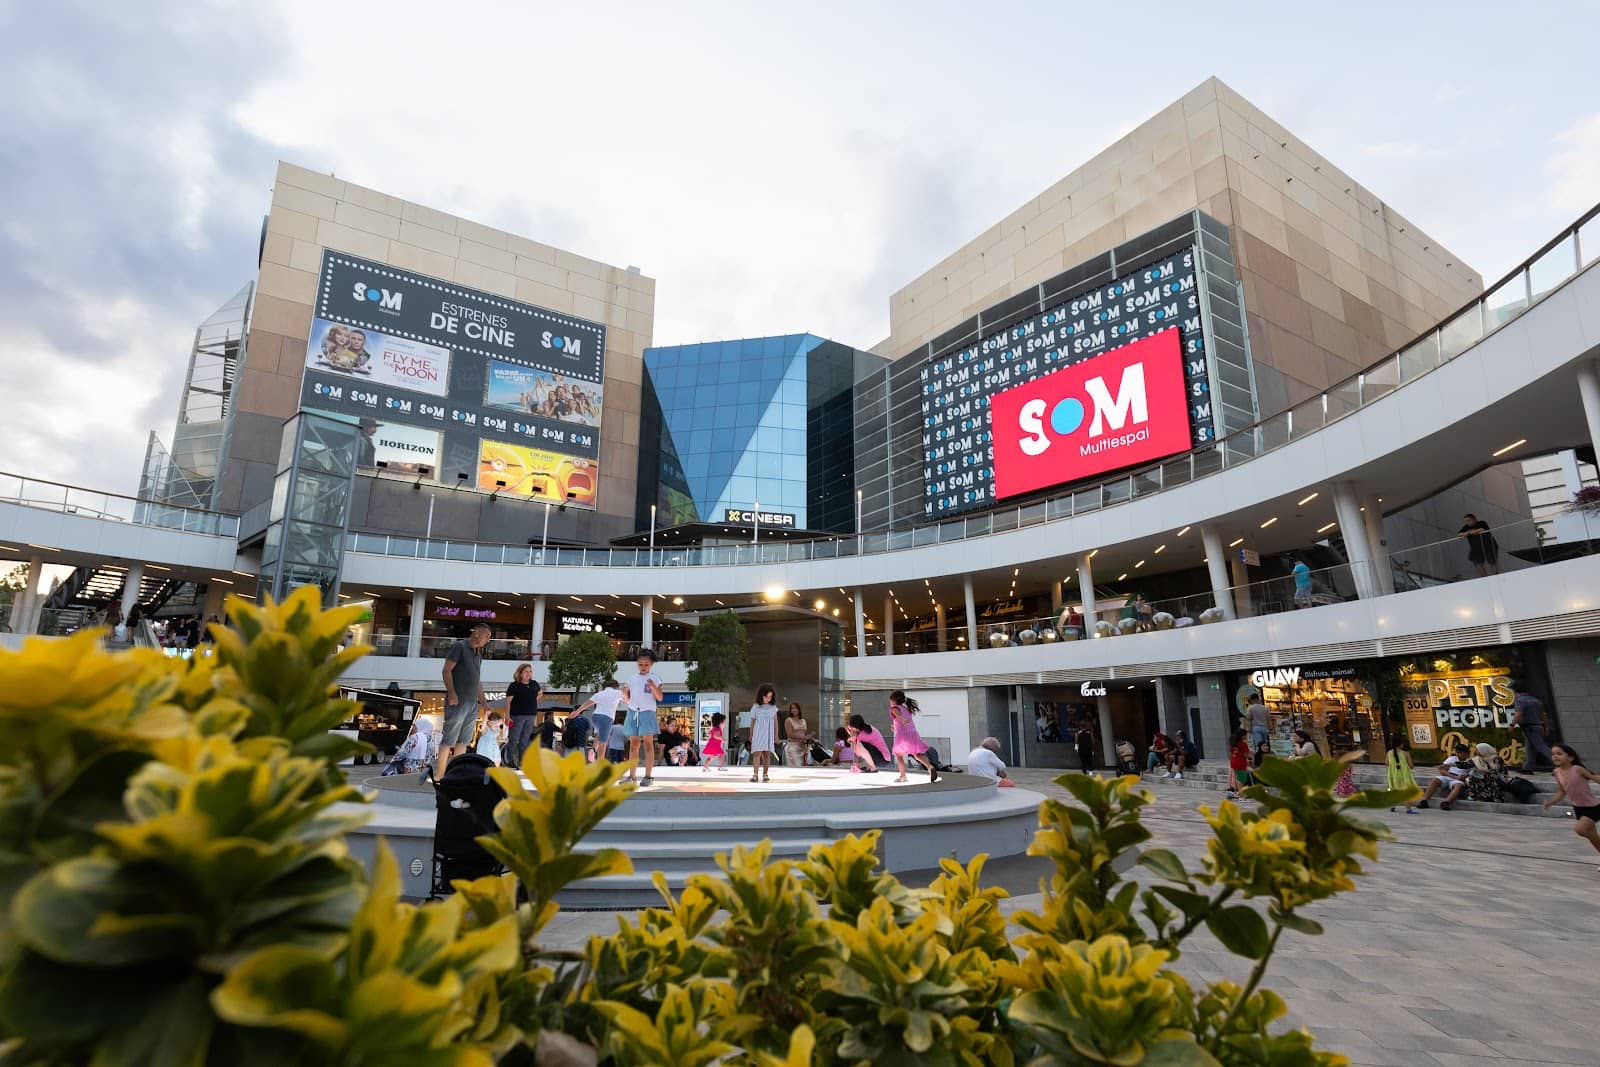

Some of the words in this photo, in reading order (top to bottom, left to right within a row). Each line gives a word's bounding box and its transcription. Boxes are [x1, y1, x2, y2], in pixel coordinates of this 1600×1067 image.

[352, 282, 403, 310] SOM
[441, 301, 508, 329] ESTRENES
[430, 312, 458, 334] DE
[464, 322, 515, 348] CINE
[541, 331, 581, 355] SOM
[384, 351, 408, 364] FLY
[411, 358, 431, 369] ME
[395, 364, 437, 381] MOON
[314, 383, 342, 398] SOM
[351, 390, 378, 405] SOM
[386, 398, 411, 411] SOM
[420, 404, 444, 417] SOM
[452, 410, 476, 424] SOM
[483, 417, 506, 430] SOM
[513, 423, 536, 435] SOM
[542, 428, 564, 440] SOM
[570, 434, 591, 446] SOM
[1019, 362, 1148, 456] SOM
[379, 439, 435, 454] HORIZON
[742, 512, 792, 525] CINESA
[562, 617, 594, 625] NATURAL
[1252, 667, 1300, 687] GUAW
[1081, 681, 1106, 697] Forus
[1428, 676, 1515, 708] PETS
[1407, 700, 1428, 710] 300
